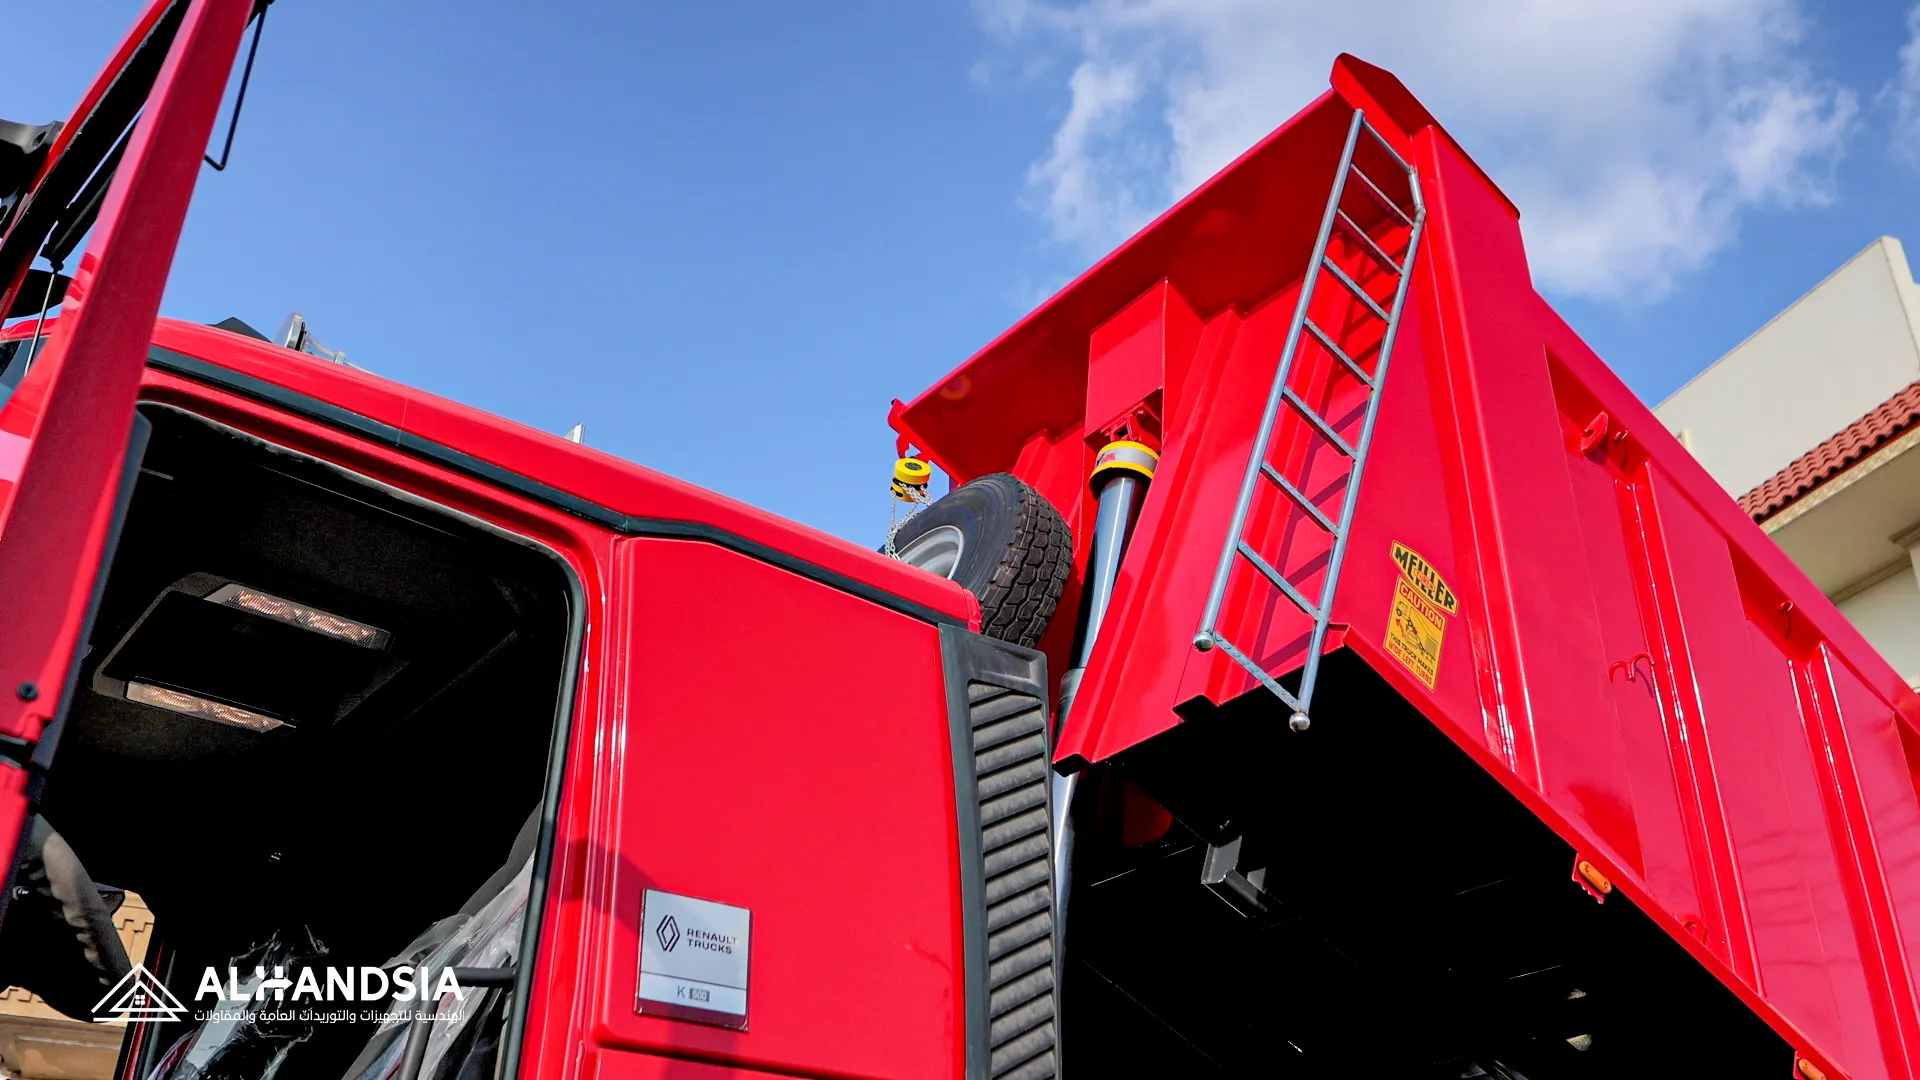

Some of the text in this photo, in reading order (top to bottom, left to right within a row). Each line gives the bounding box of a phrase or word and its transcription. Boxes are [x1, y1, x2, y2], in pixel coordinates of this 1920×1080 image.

[1395, 546, 1455, 610] MEILLER
[1400, 583, 1443, 629] CAUTION
[1388, 641, 1433, 685] WIDE LEFT TURNS
[1390, 633, 1434, 676] THIS TRUCK MAKES
[686, 928, 738, 945] RENAULT
[687, 938, 733, 955] TRUCKS
[676, 986, 686, 999] K
